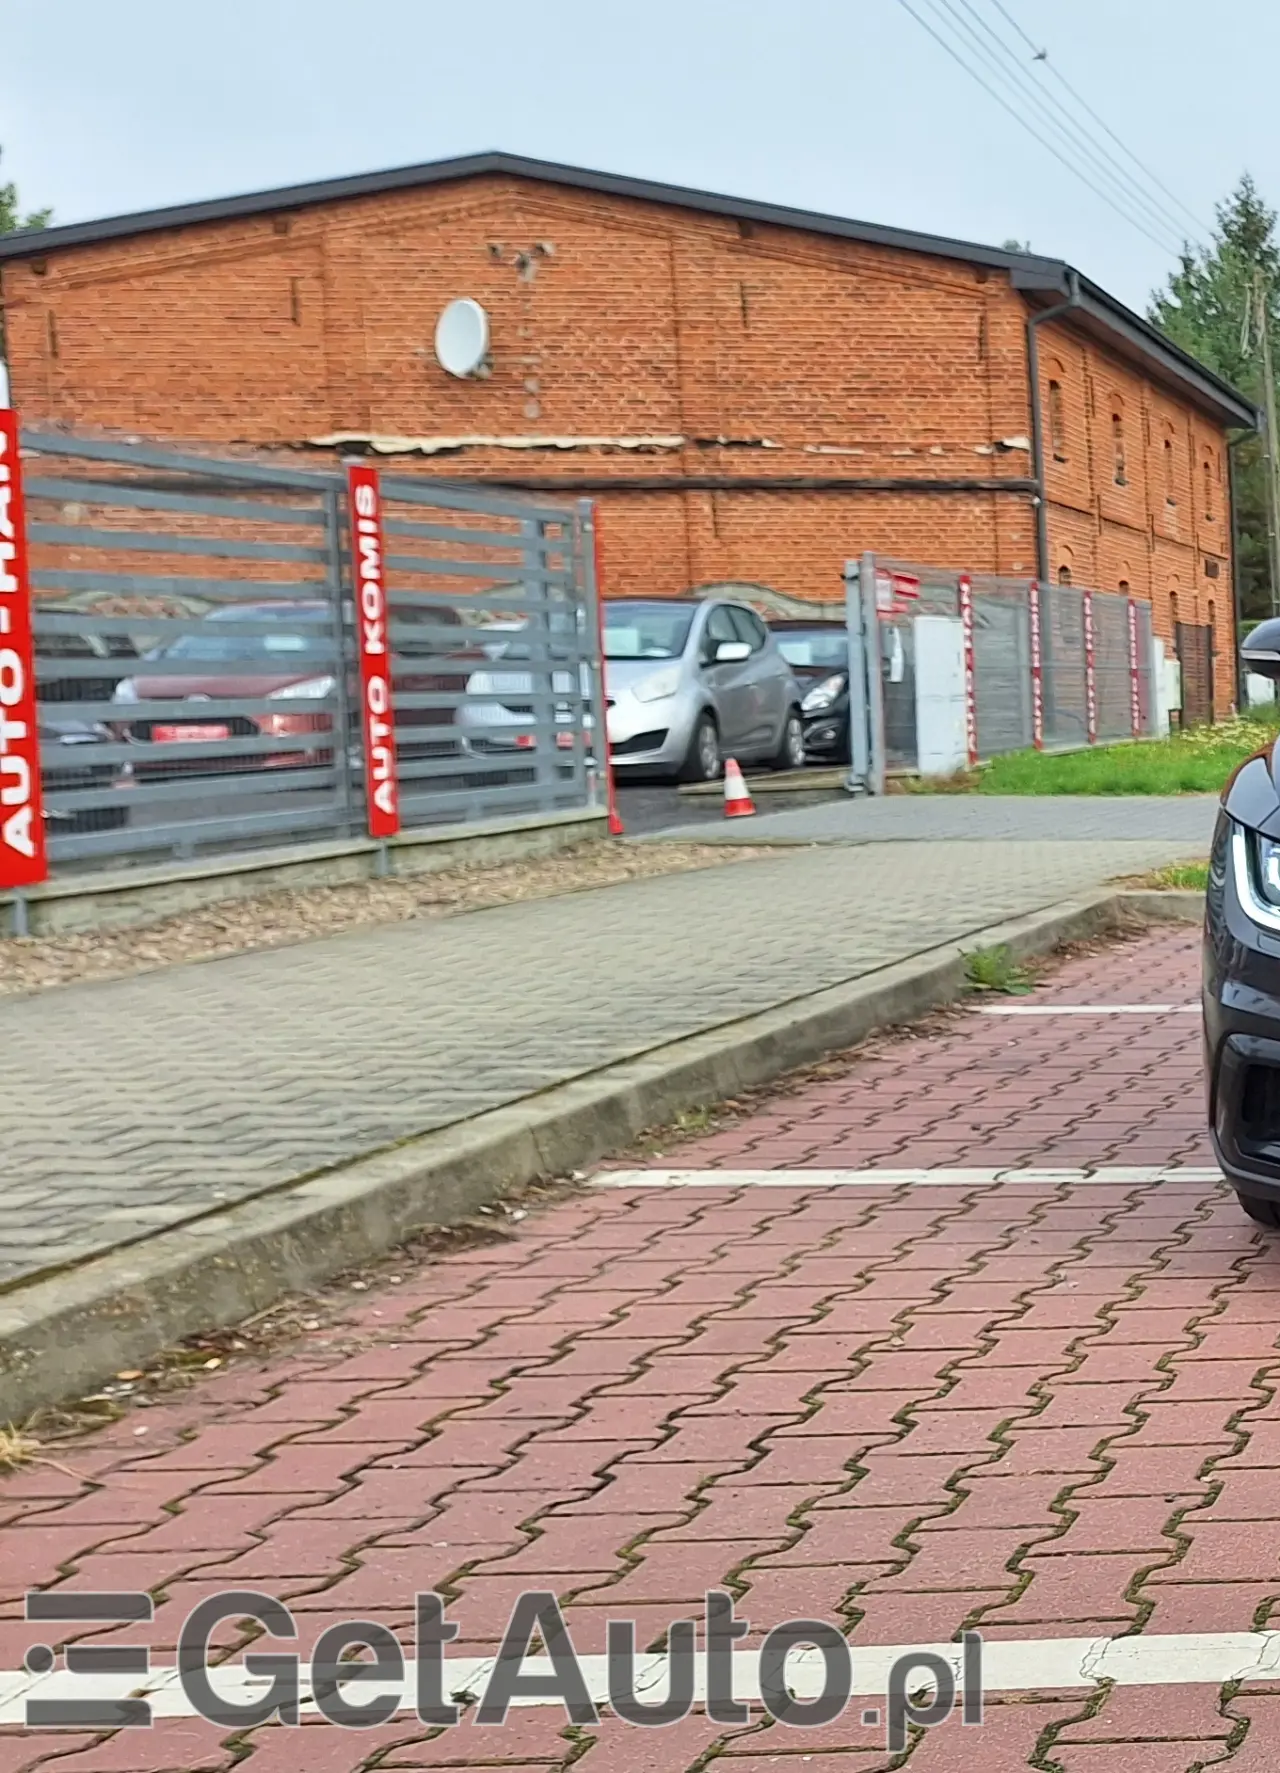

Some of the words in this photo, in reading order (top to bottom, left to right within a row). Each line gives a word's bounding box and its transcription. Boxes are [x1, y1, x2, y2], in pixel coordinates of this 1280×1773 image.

[355, 484, 385, 655] KOMIS
[0, 648, 35, 857] AUTO
[367, 675, 396, 815] AUTO
